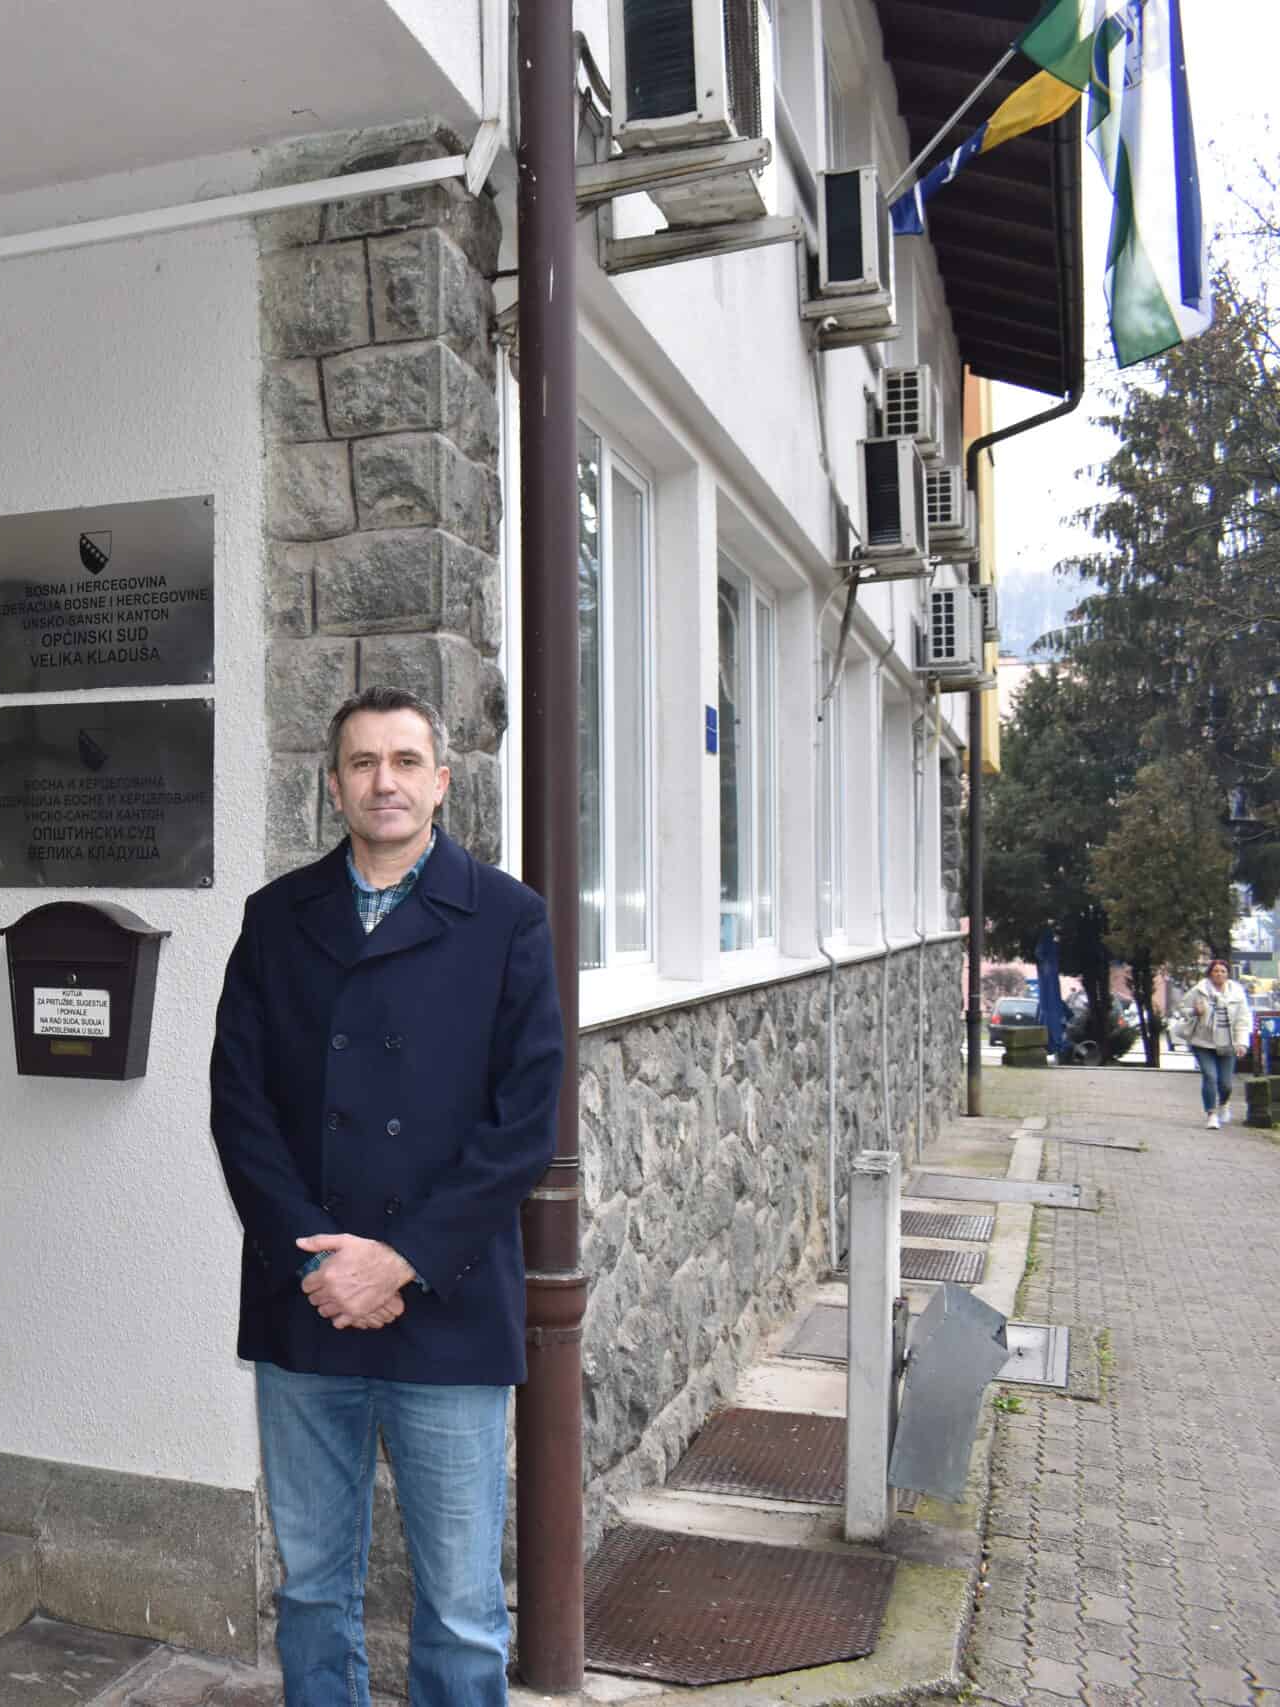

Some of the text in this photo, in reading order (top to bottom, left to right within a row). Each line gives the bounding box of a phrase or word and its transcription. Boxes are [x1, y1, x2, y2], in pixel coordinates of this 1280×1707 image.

[24, 583, 66, 598] BOSNA
[77, 575, 167, 593] HERCEGOVINA
[64, 596, 106, 610] BOSNE
[117, 588, 209, 606] HERCEGOVINE
[117, 607, 169, 622] KANTON
[116, 626, 149, 642] SUD
[30, 652, 82, 668] VELIKA
[127, 825, 157, 842] СУД
